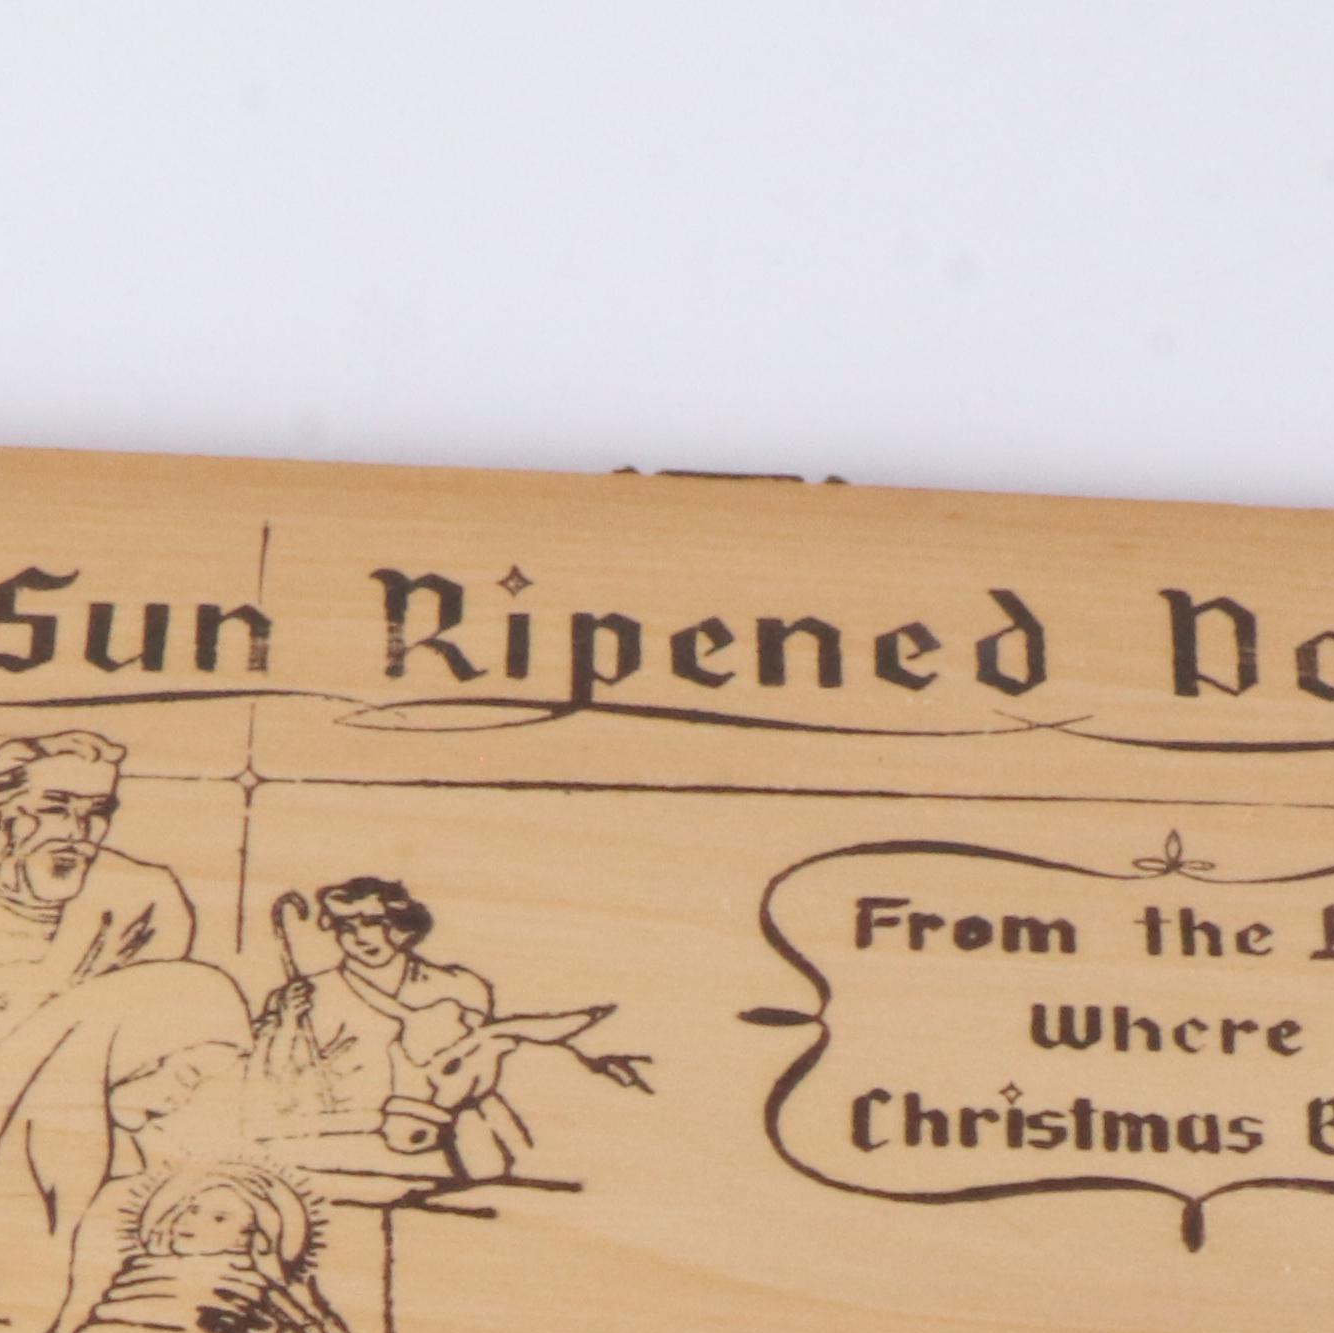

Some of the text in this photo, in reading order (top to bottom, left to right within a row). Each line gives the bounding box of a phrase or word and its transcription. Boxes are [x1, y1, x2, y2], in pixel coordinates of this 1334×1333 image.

[369, 567, 1049, 706] Ripened
[854, 896, 1077, 955] From
[1134, 905, 1273, 958] the
[1029, 1003, 1303, 1057] Where
[850, 1081, 1264, 1155] Christmas
